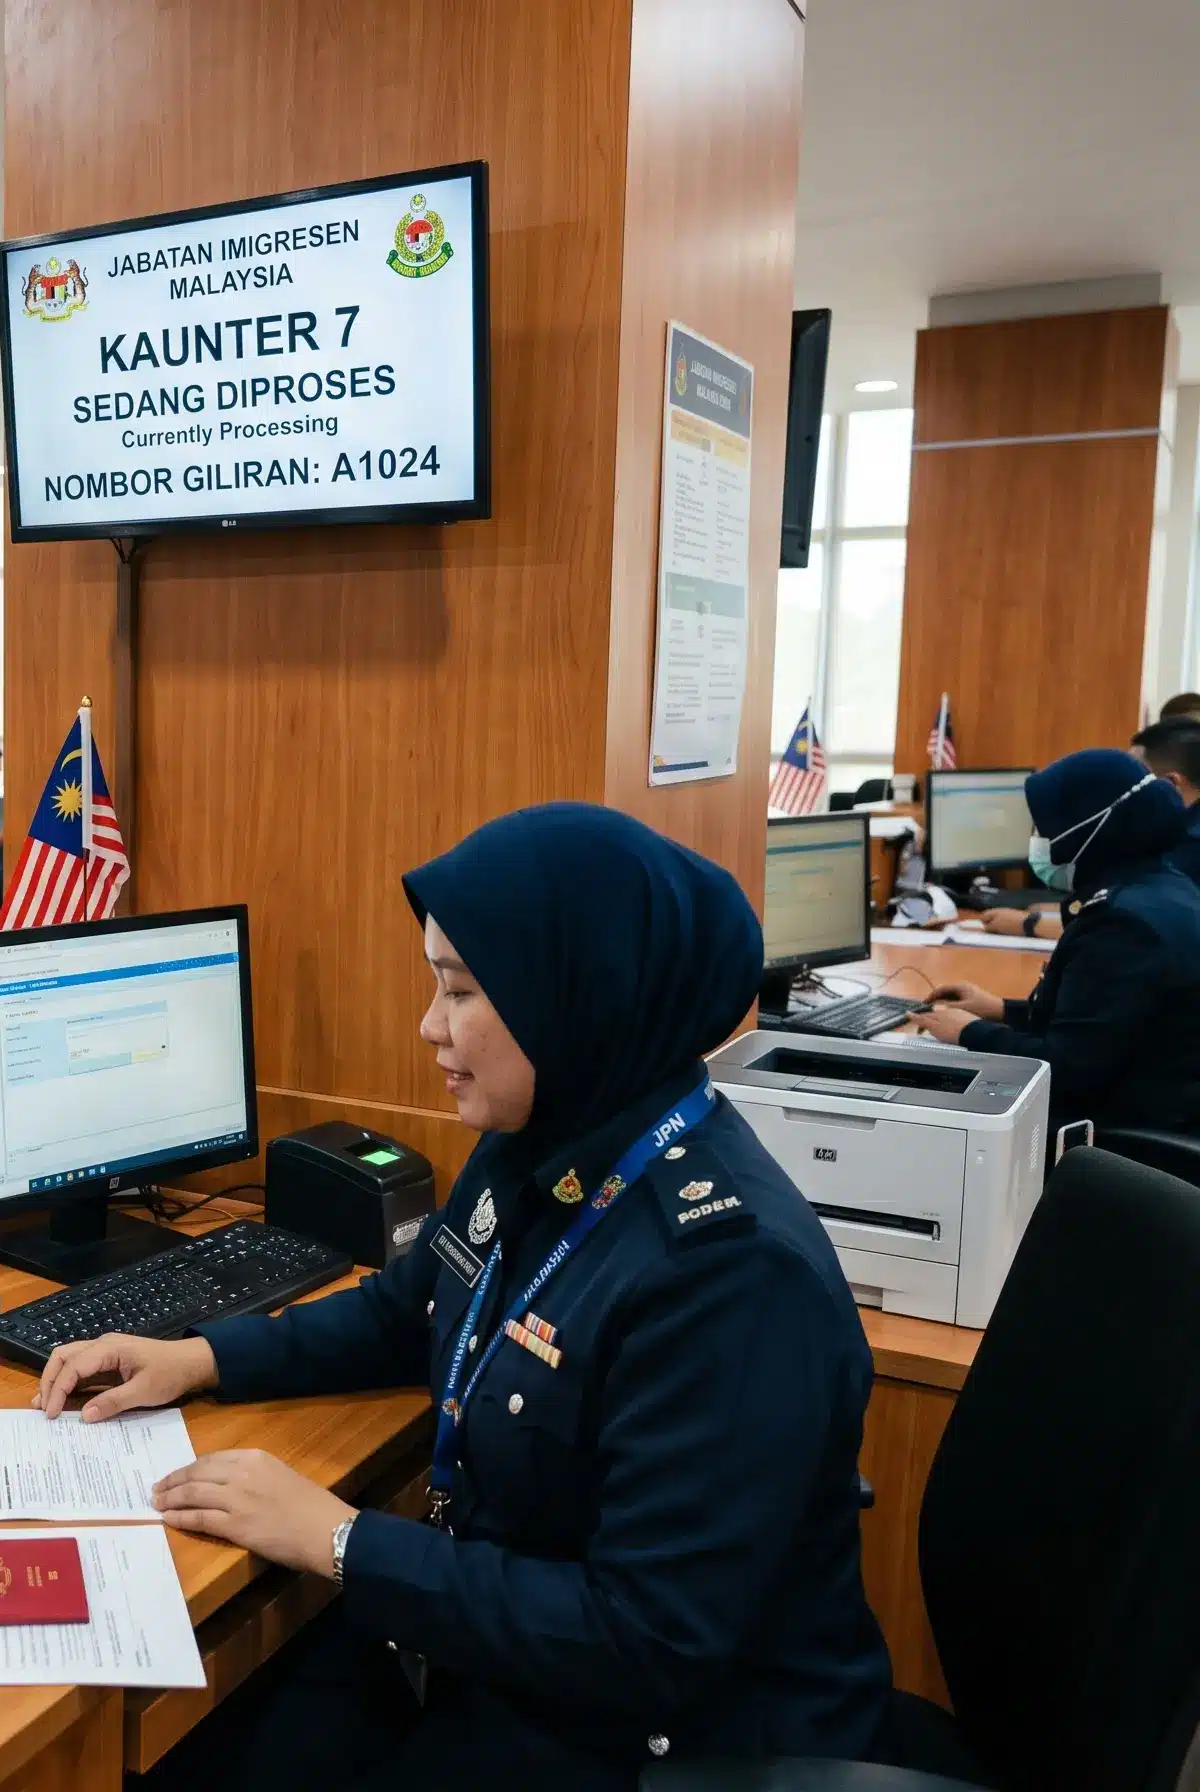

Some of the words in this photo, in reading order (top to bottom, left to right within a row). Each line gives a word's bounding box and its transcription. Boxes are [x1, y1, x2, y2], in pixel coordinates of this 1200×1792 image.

[108, 242, 213, 278] JABATAN
[221, 219, 360, 262] IMIGRESEN
[170, 262, 294, 300] MALAYSIA
[100, 309, 320, 374] KAUNTER
[335, 305, 361, 348] 7
[73, 384, 205, 424] SEDANG
[217, 365, 396, 411] DIPROSES
[122, 425, 213, 449] Currently
[220, 415, 339, 442] Processing
[45, 468, 174, 502] NOMBOR
[183, 457, 320, 492] GILIRAN:
[332, 445, 440, 483] A1024
[652, 1112, 686, 1147] JPN
